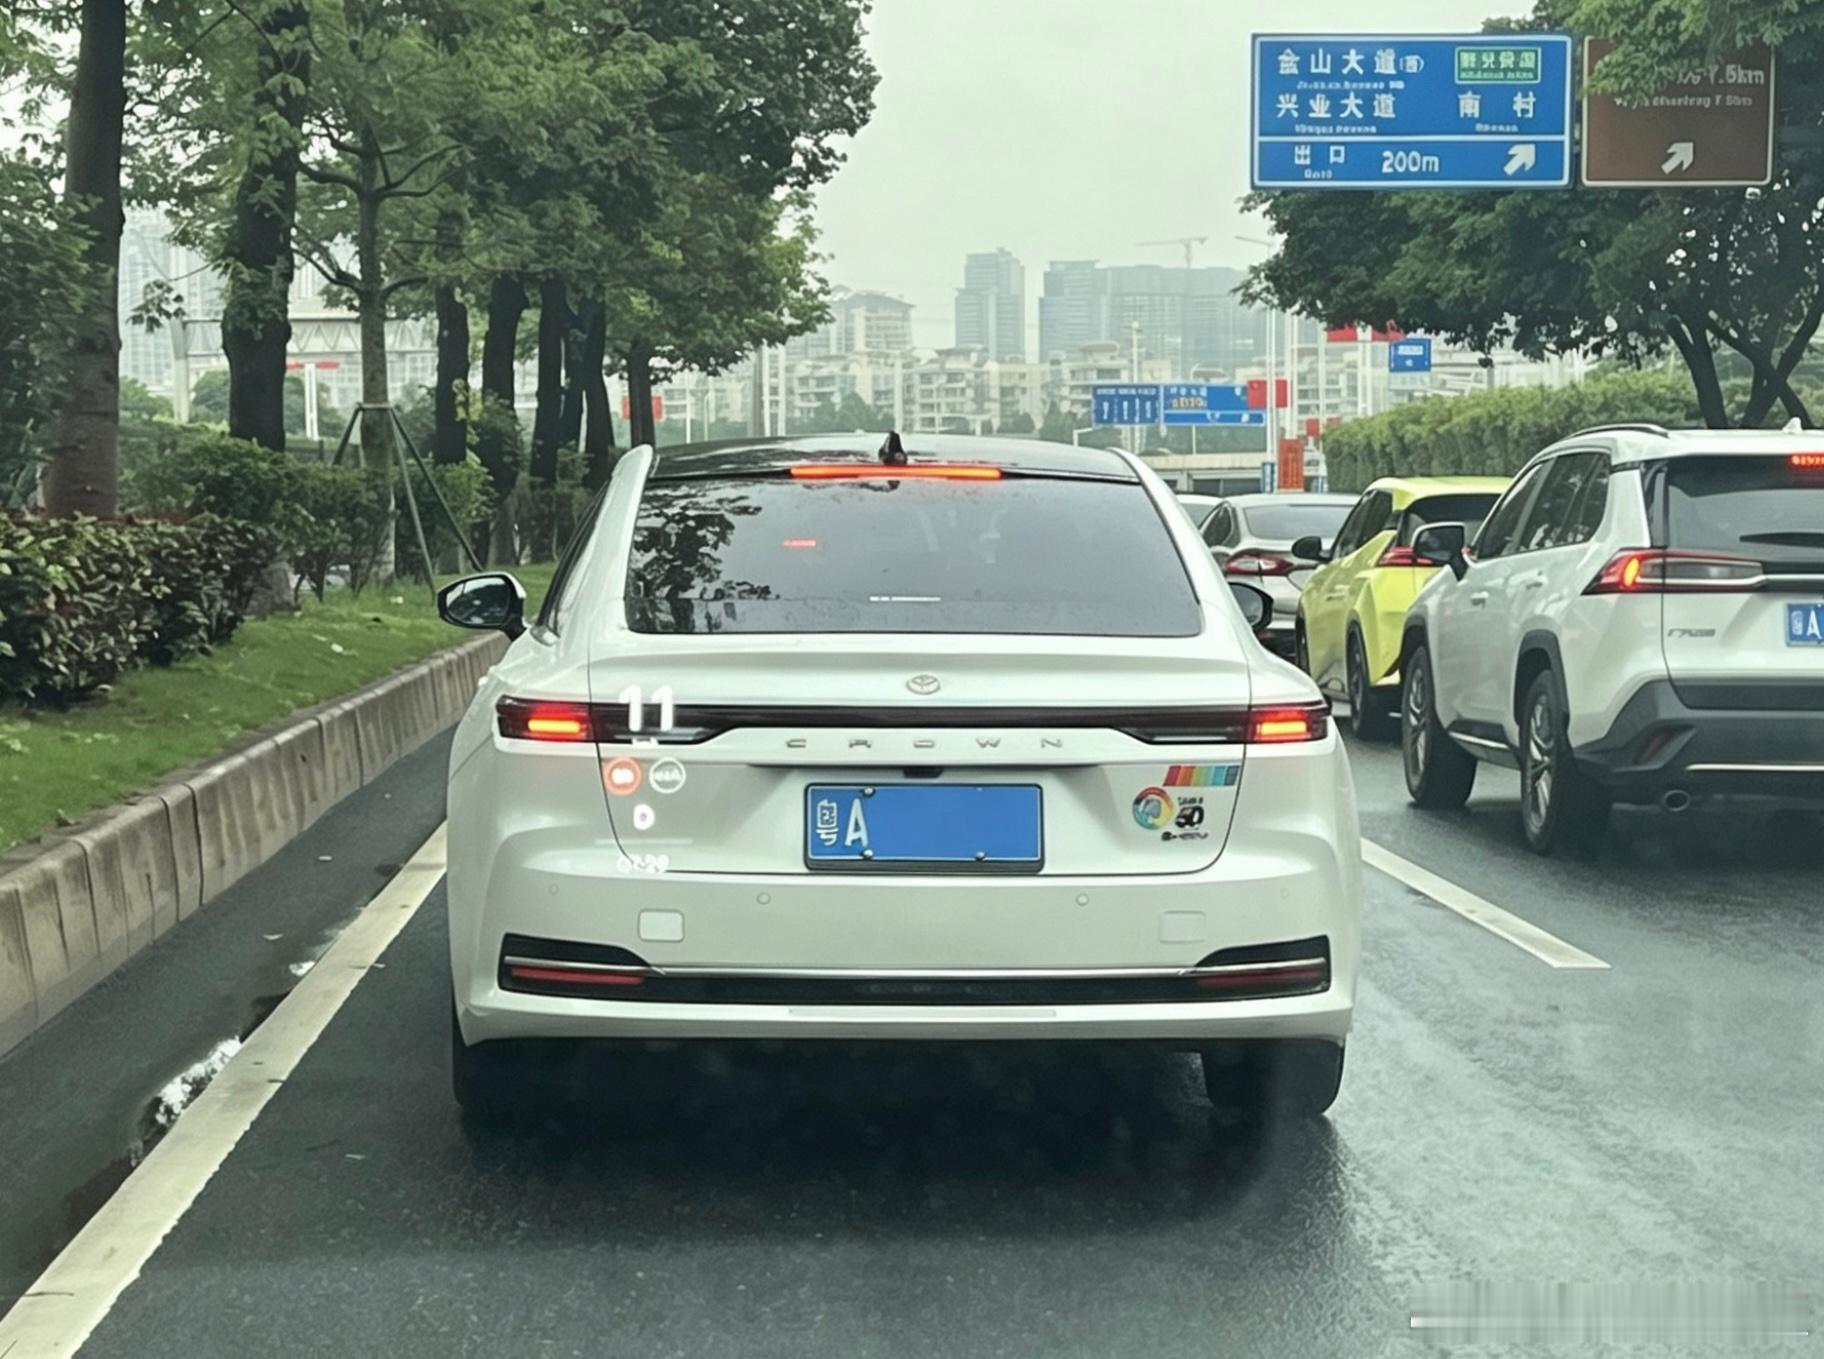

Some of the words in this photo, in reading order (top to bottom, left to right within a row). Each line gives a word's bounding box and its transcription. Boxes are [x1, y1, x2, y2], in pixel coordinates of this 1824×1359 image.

[1276, 91, 1397, 118] 兴业大道
[1457, 90, 1537, 118] 南村
[1294, 144, 1346, 165] 出口
[1381, 150, 1440, 173] 200m
[618, 685, 675, 732] 11
[785, 738, 1063, 749] CROWN
